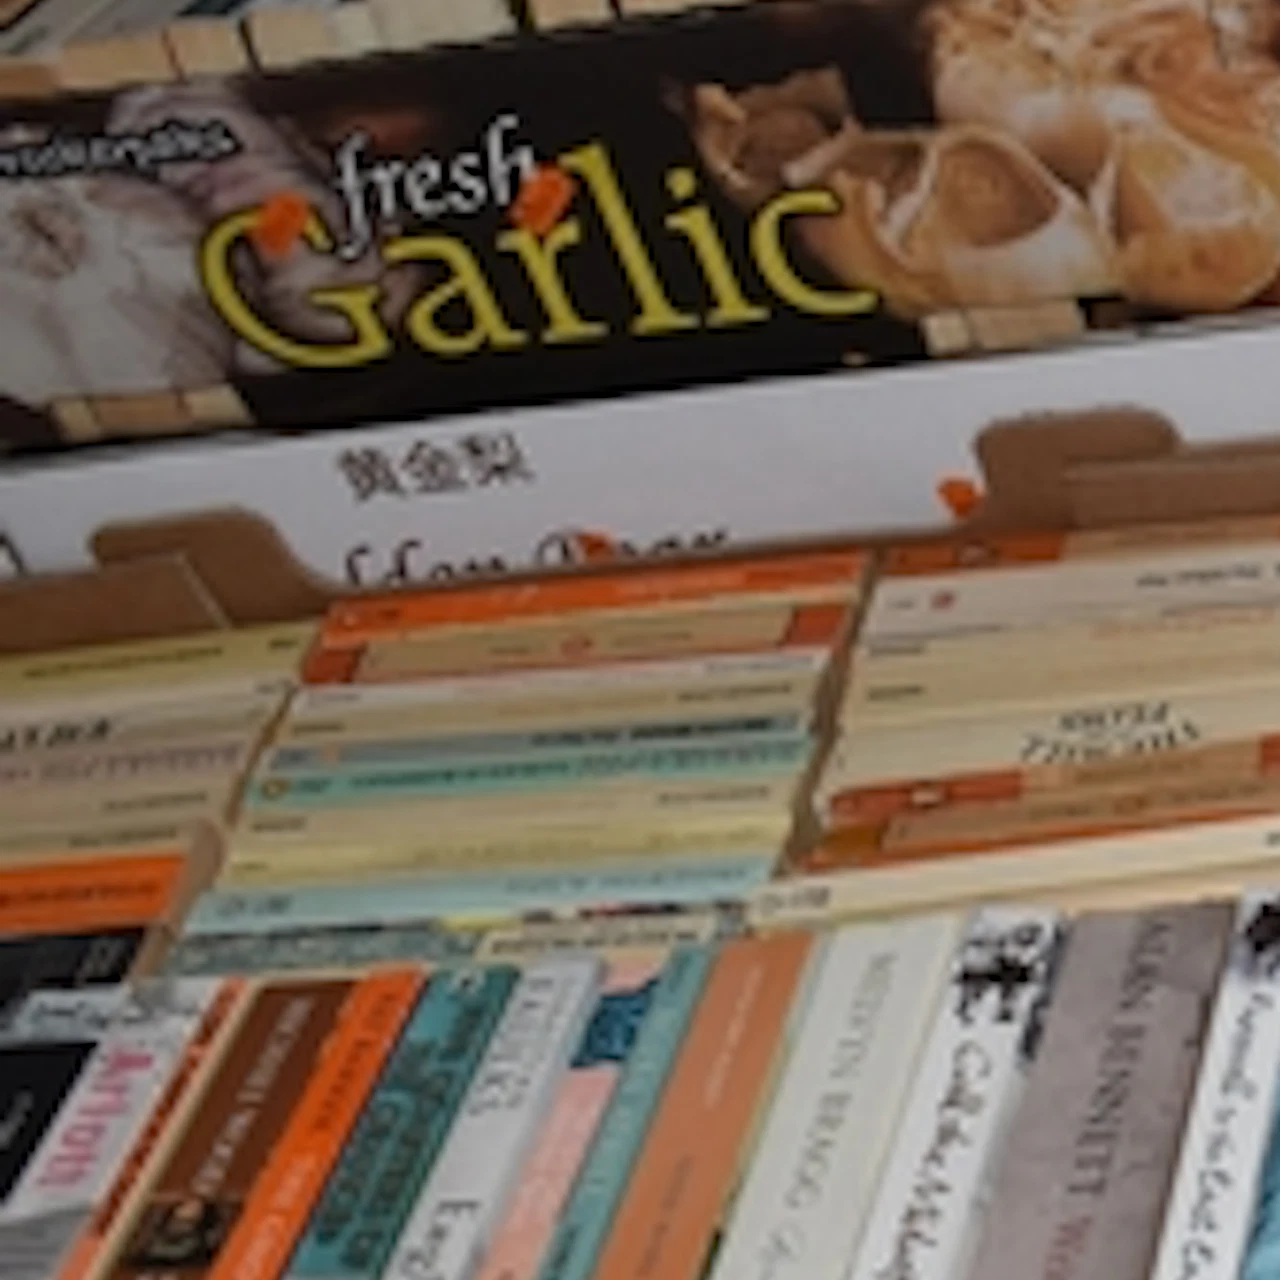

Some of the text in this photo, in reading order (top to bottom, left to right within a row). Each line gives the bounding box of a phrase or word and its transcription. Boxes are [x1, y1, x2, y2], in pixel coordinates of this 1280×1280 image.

[199, 140, 884, 372] Garlic
[336, 113, 538, 260] fresh
[1066, 1022, 1148, 1196] BENNETT
